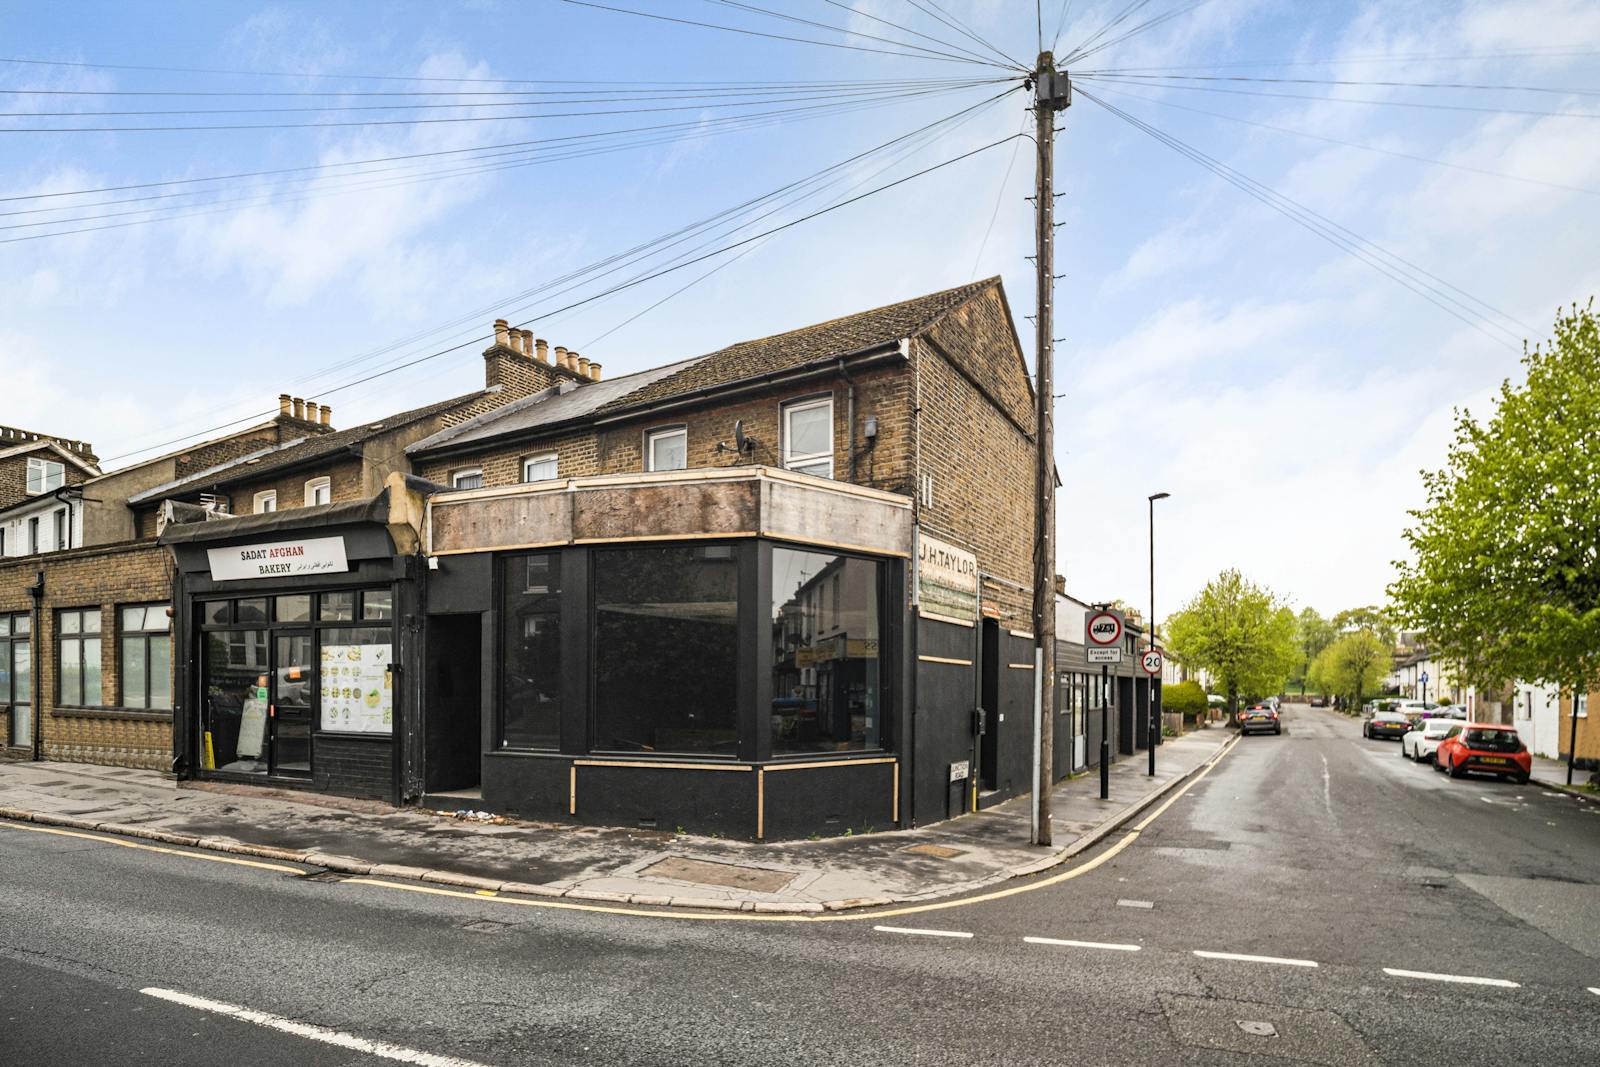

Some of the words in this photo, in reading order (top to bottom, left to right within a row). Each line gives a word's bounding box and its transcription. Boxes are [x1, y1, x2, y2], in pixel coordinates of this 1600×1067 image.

[240, 549, 267, 561] SADAT
[269, 546, 304, 558] AFGHAN
[258, 563, 291, 575] BAKERY
[1145, 657, 1161, 668] 20
